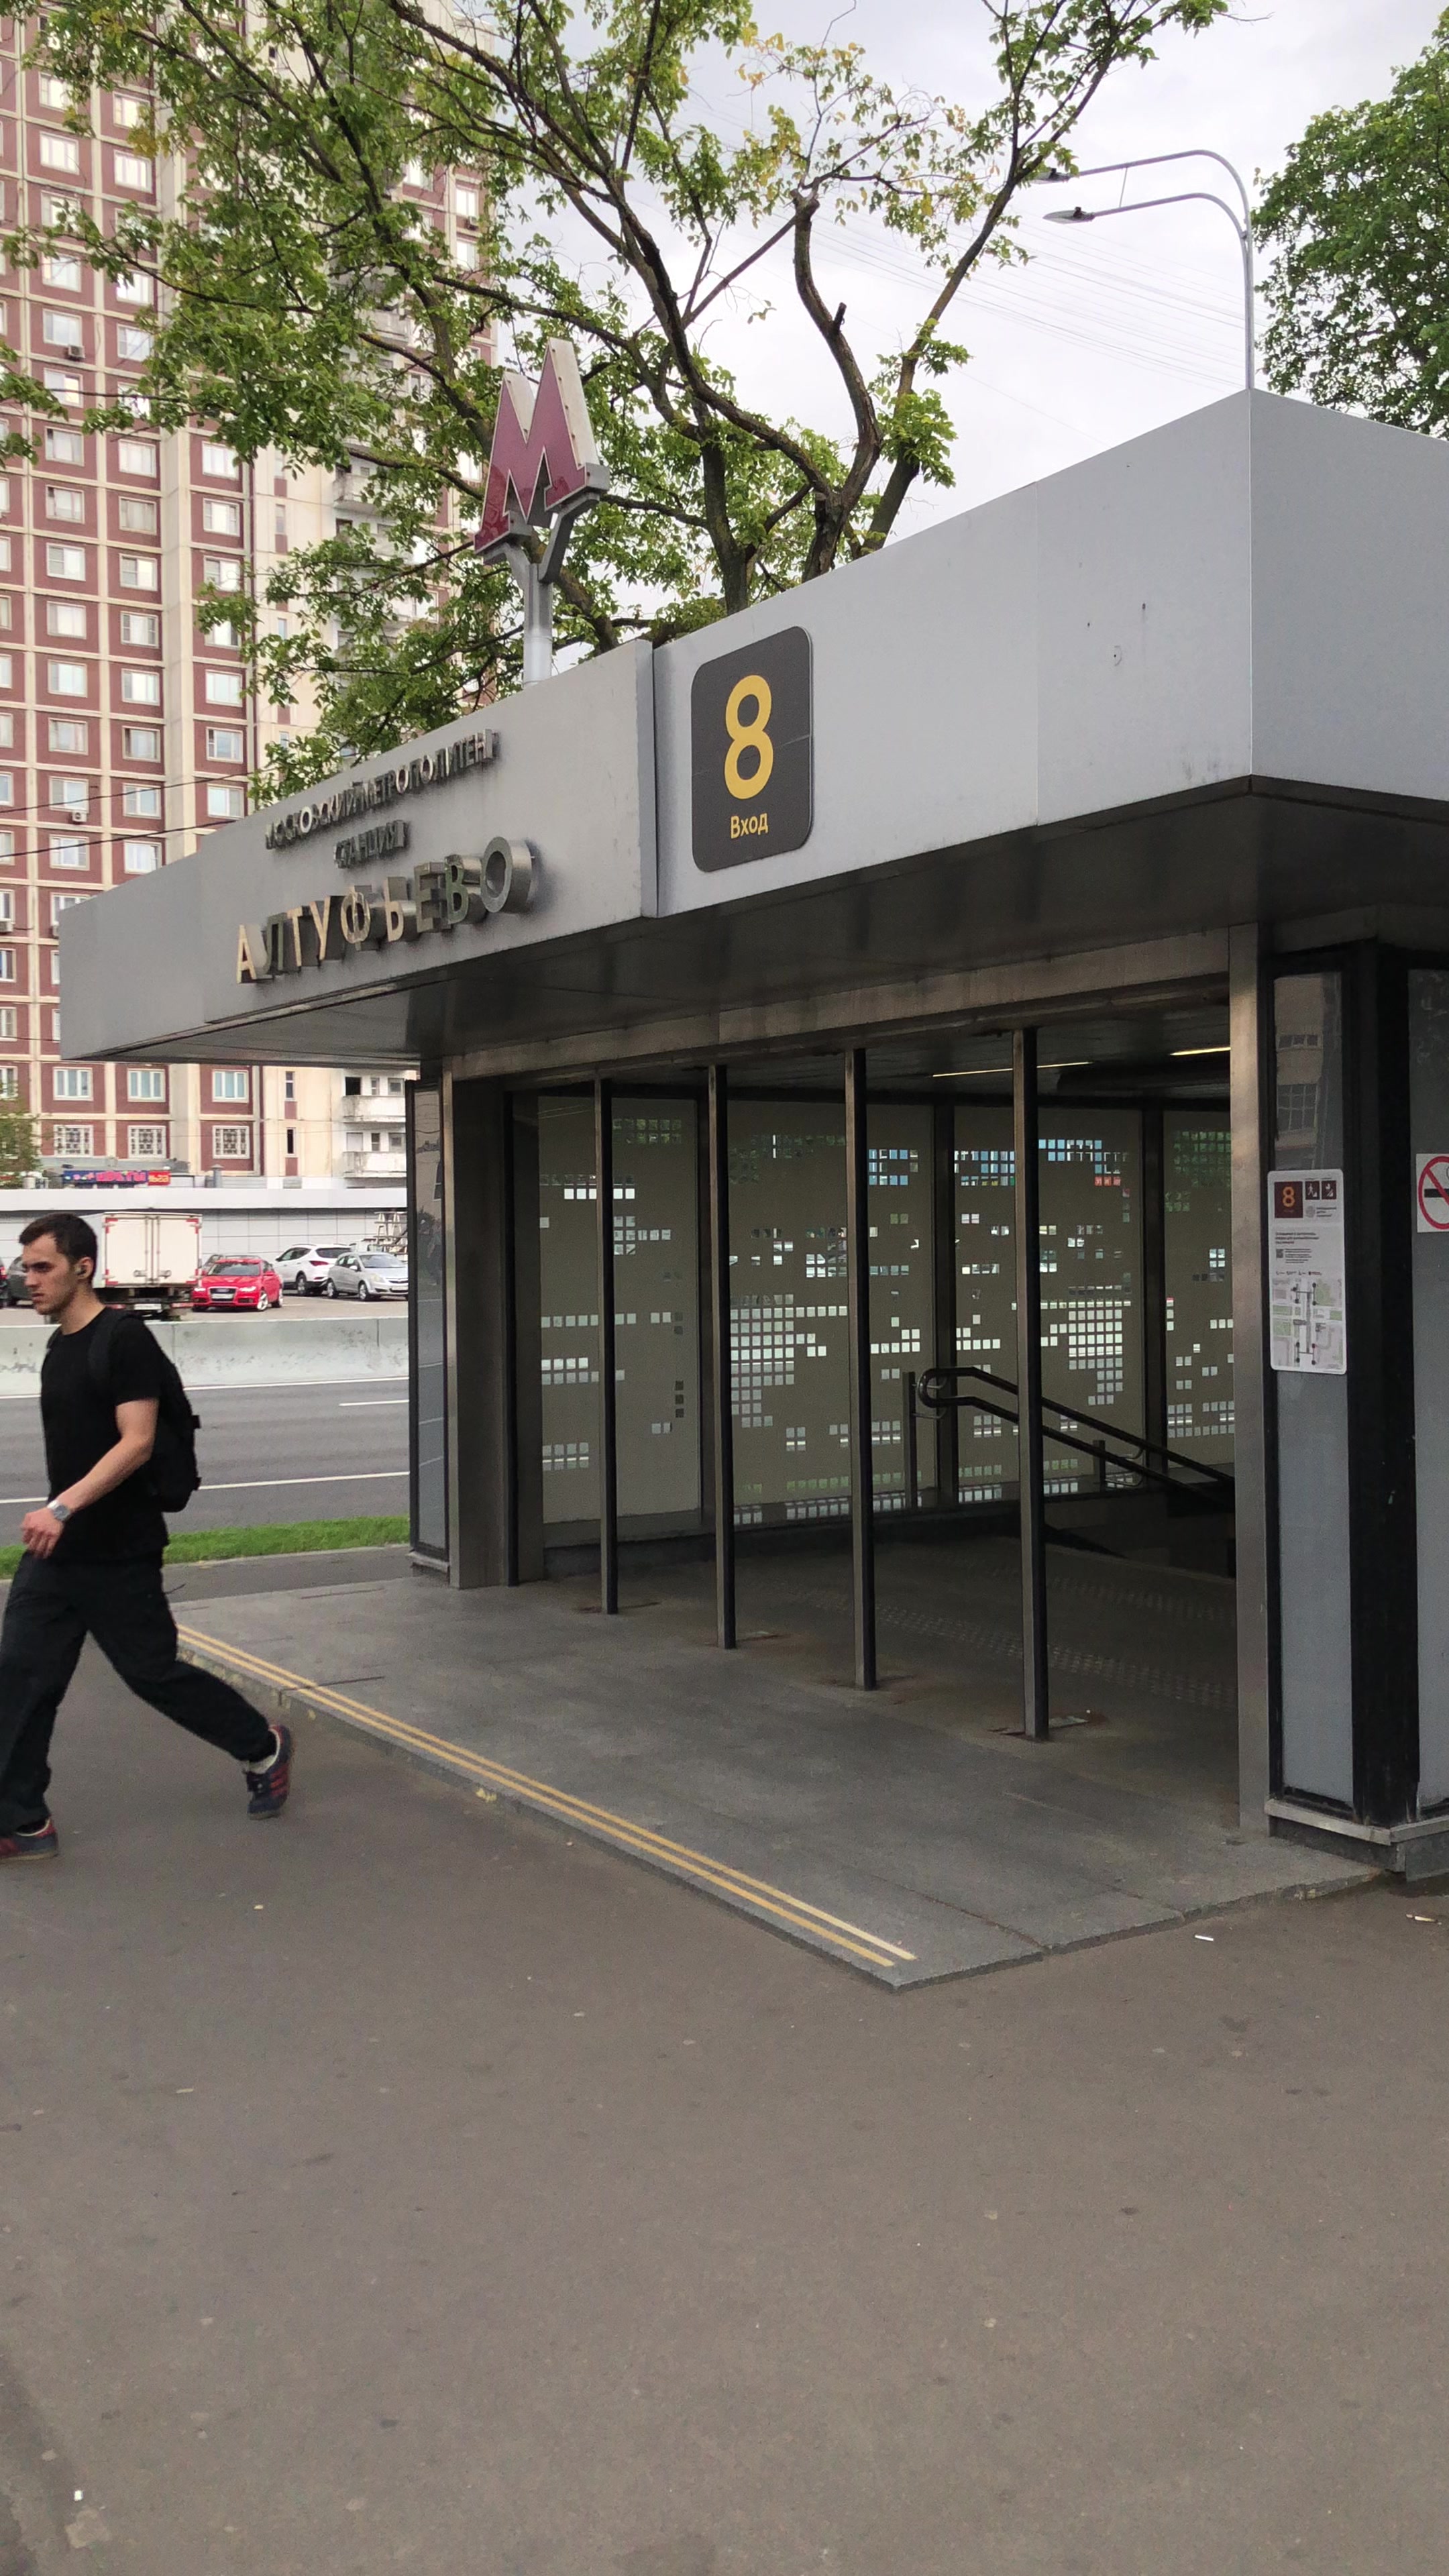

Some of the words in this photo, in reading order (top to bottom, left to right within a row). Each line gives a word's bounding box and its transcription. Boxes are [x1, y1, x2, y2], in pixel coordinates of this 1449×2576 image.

[724, 675, 773, 799] 8
[730, 812, 769, 839] Вход
[236, 836, 527, 985] АЛТУФЬЕВО
[1282, 1186, 1295, 1208] 8
